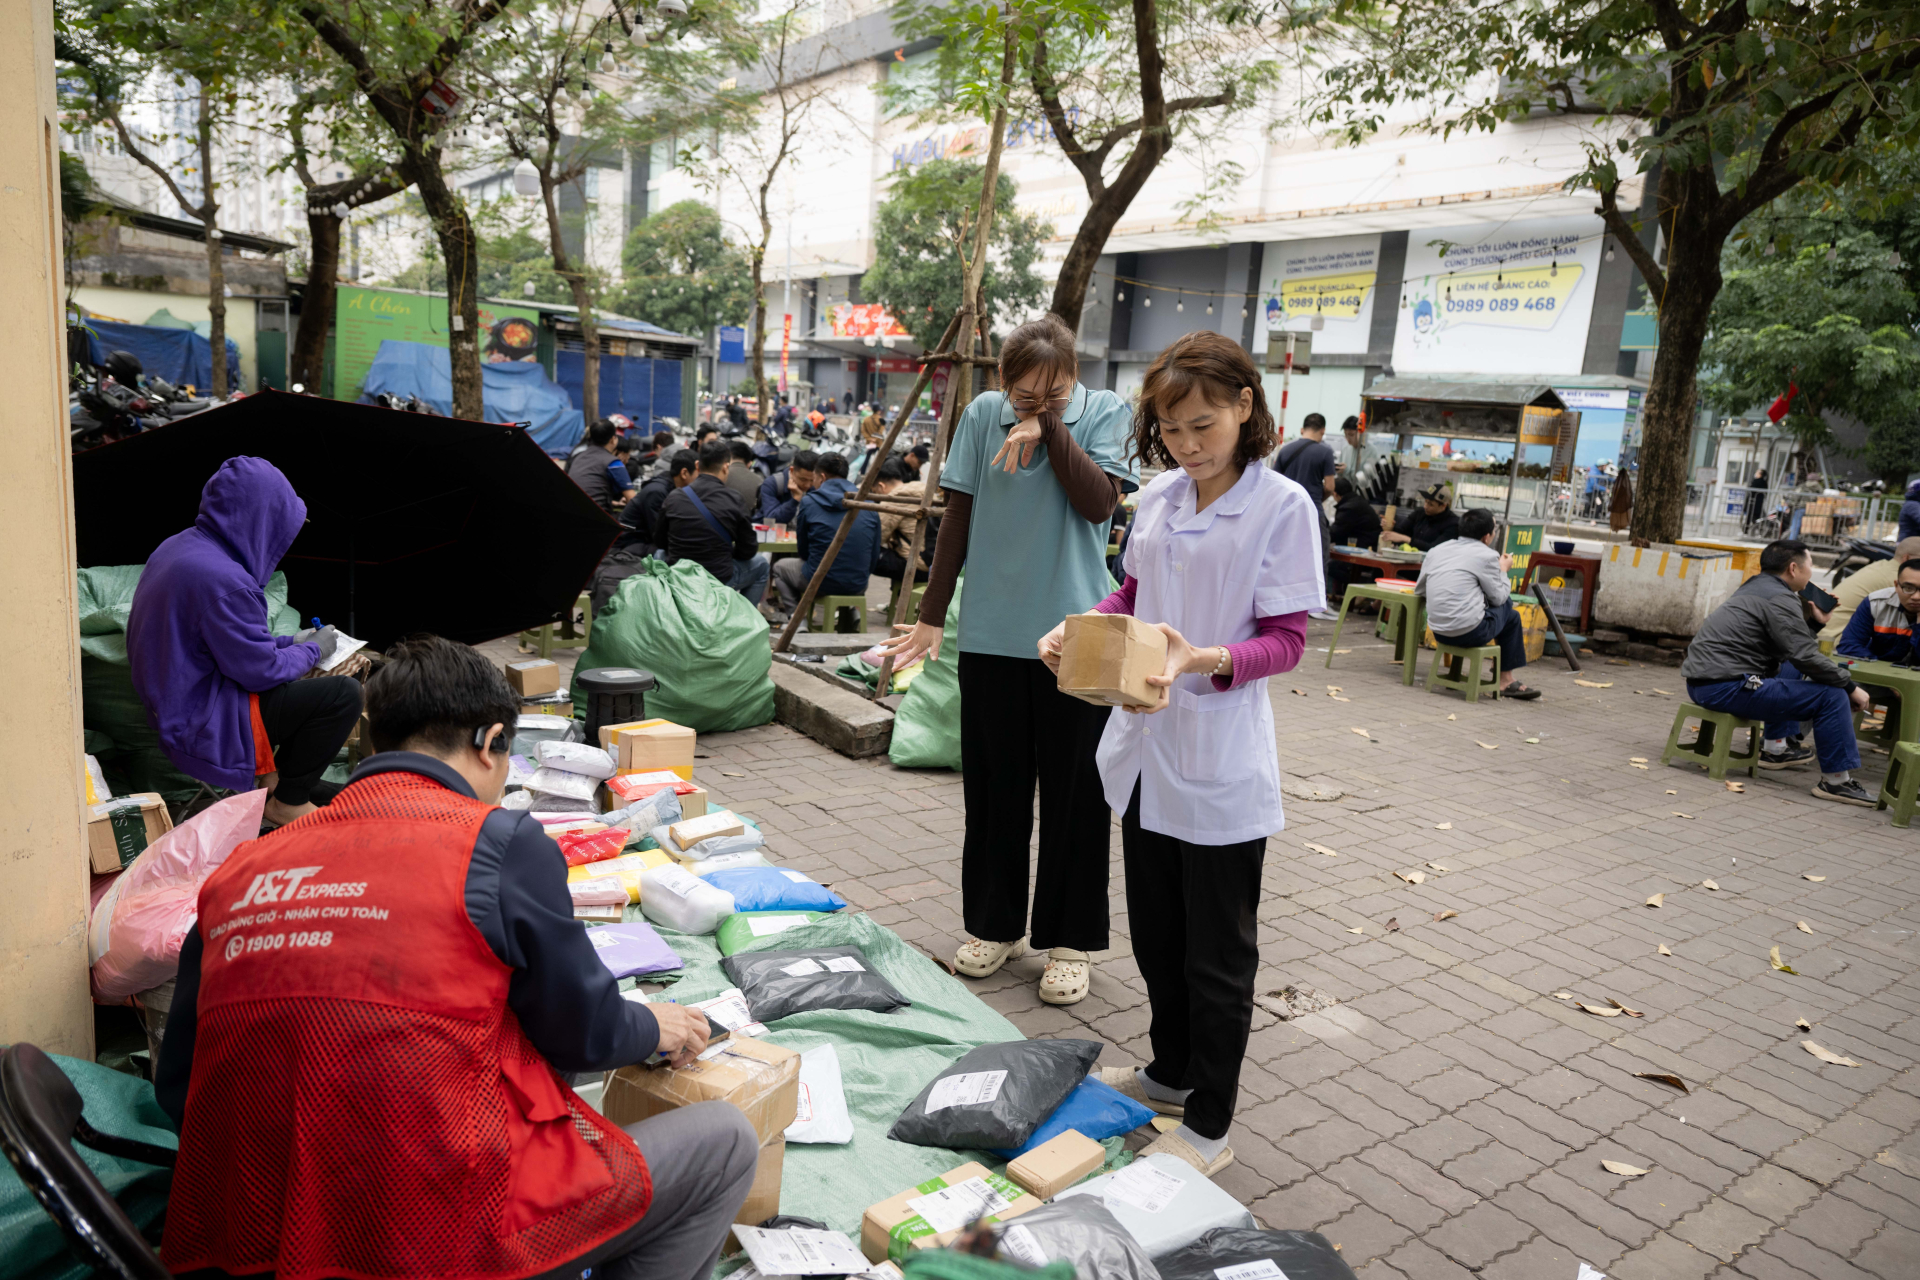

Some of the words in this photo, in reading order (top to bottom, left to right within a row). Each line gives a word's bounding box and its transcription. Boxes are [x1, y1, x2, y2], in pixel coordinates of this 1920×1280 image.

[1477, 242, 1491, 253] TÔI
[1494, 240, 1519, 251] LUÔN
[1456, 280, 1475, 292] LIÊN
[1288, 297, 1313, 308] 0989
[1316, 296, 1336, 307] 089
[1339, 295, 1360, 306] 468
[1447, 298, 1484, 312] 0989
[1489, 298, 1519, 312] 089
[1524, 297, 1556, 311] 468
[1511, 554, 1532, 569] HAN
[229, 866, 324, 912] J&T
[296, 881, 368, 900] EXPRESS
[210, 922, 227, 940] GIAO
[227, 914, 255, 931] ĐÚNG
[256, 909, 278, 925] GIỜ
[284, 905, 320, 921] NHẬN
[321, 906, 350, 918] CHU
[352, 904, 390, 921] TOÀN
[246, 933, 285, 953] 1900
[288, 930, 334, 948] 1088
